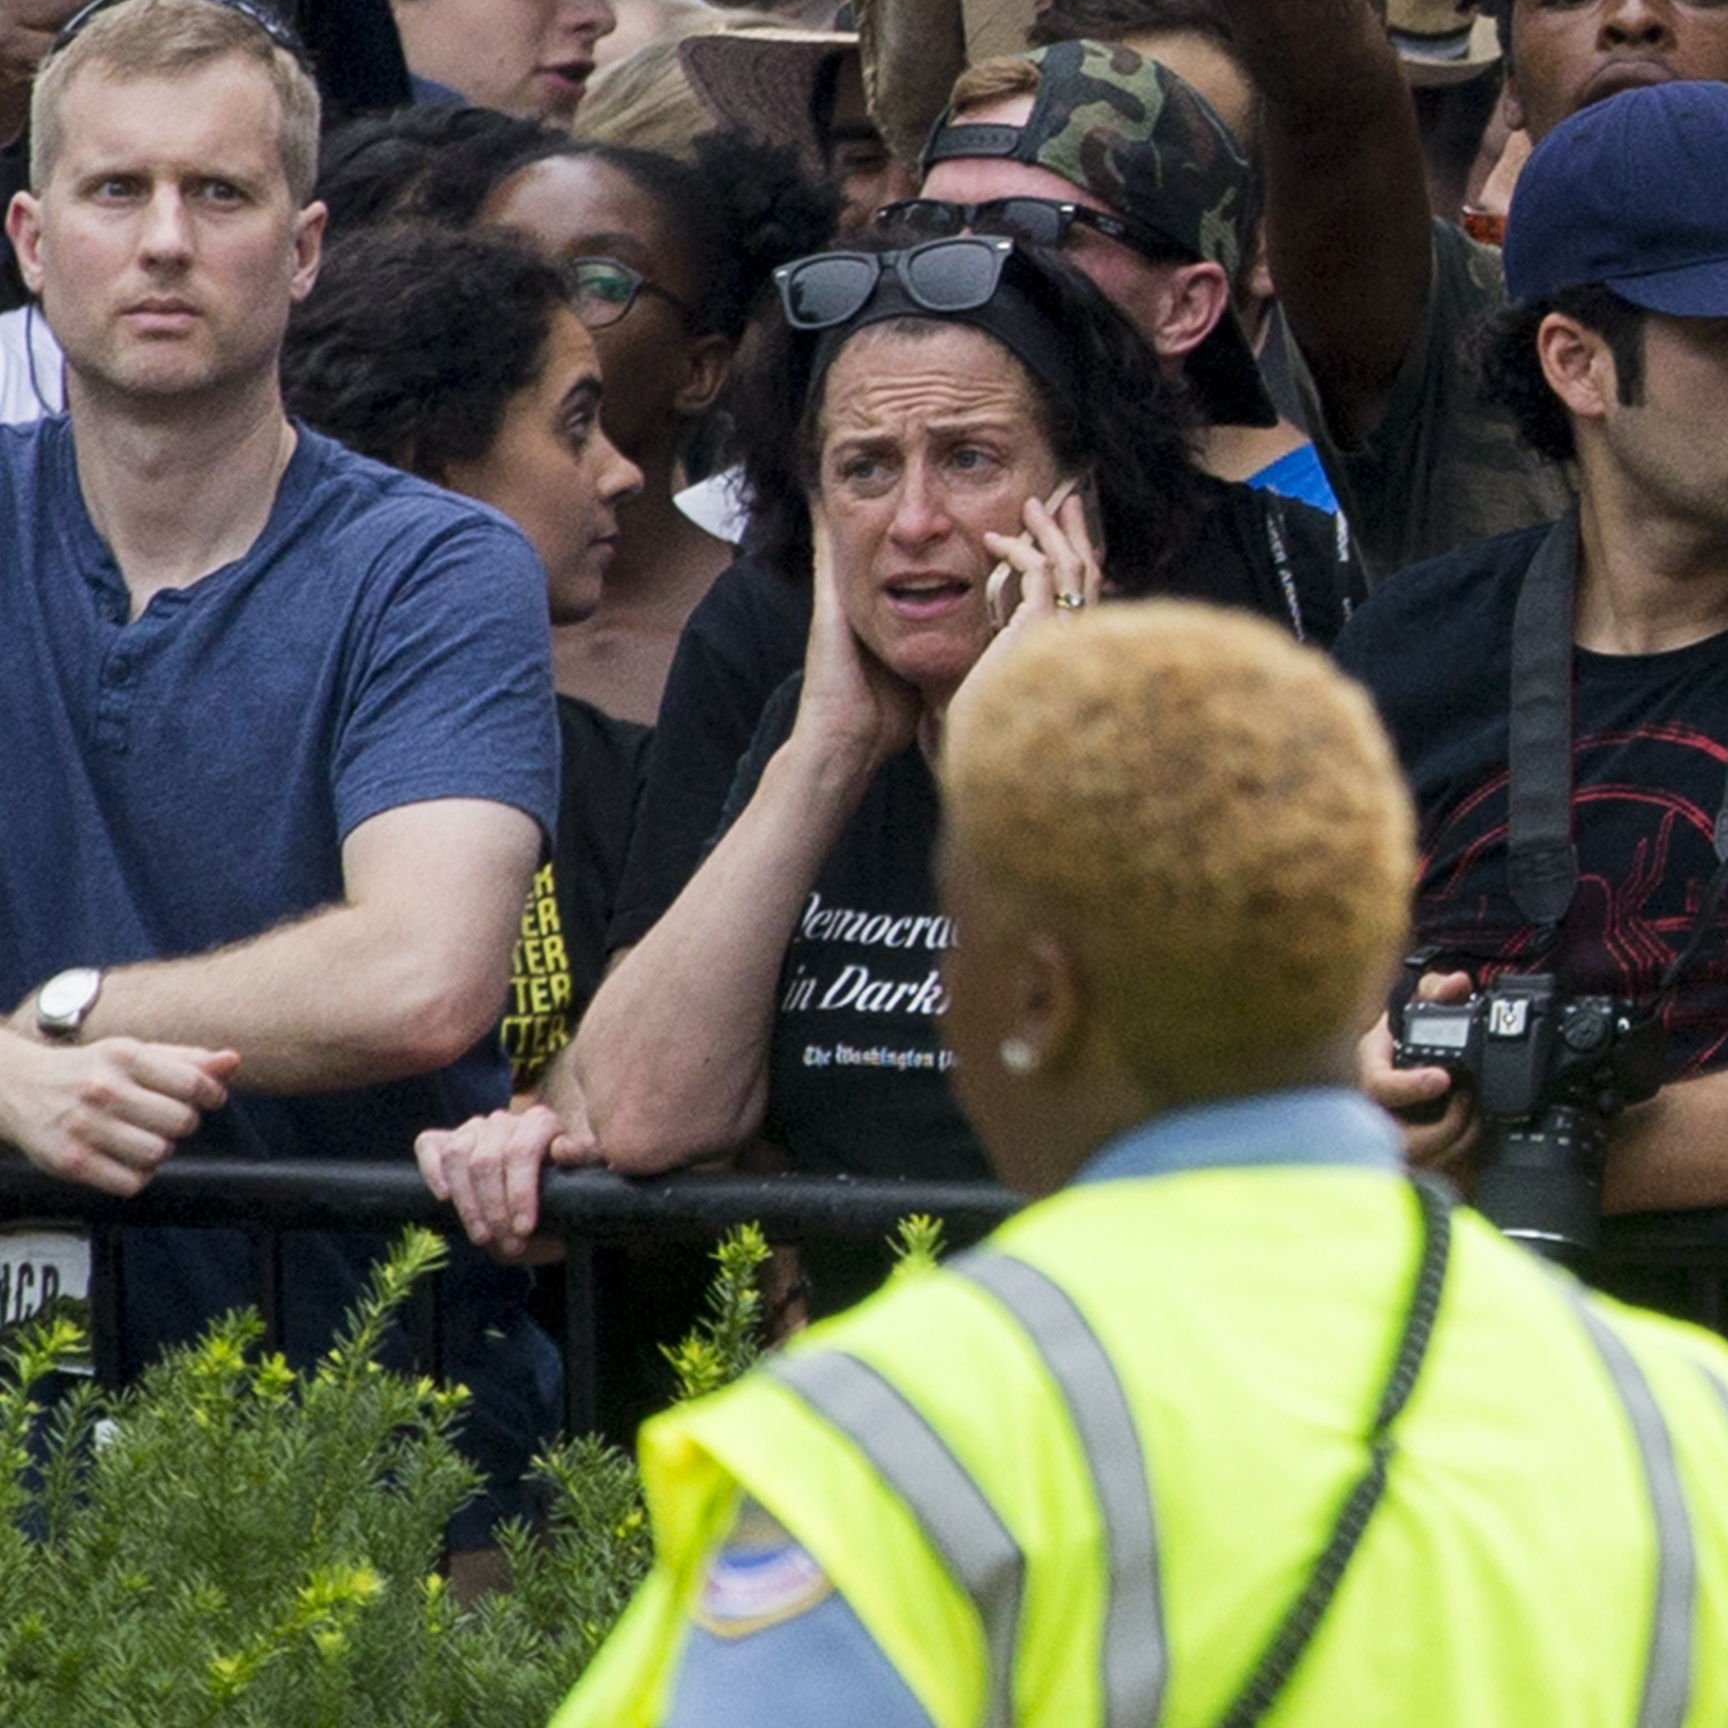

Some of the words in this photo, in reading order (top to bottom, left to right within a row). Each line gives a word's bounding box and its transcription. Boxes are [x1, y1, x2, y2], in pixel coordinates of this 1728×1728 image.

[781, 965, 818, 1012] in
[817, 964, 951, 1016] Dark
[803, 1044, 832, 1066] The
[835, 1041, 934, 1071] Washington
